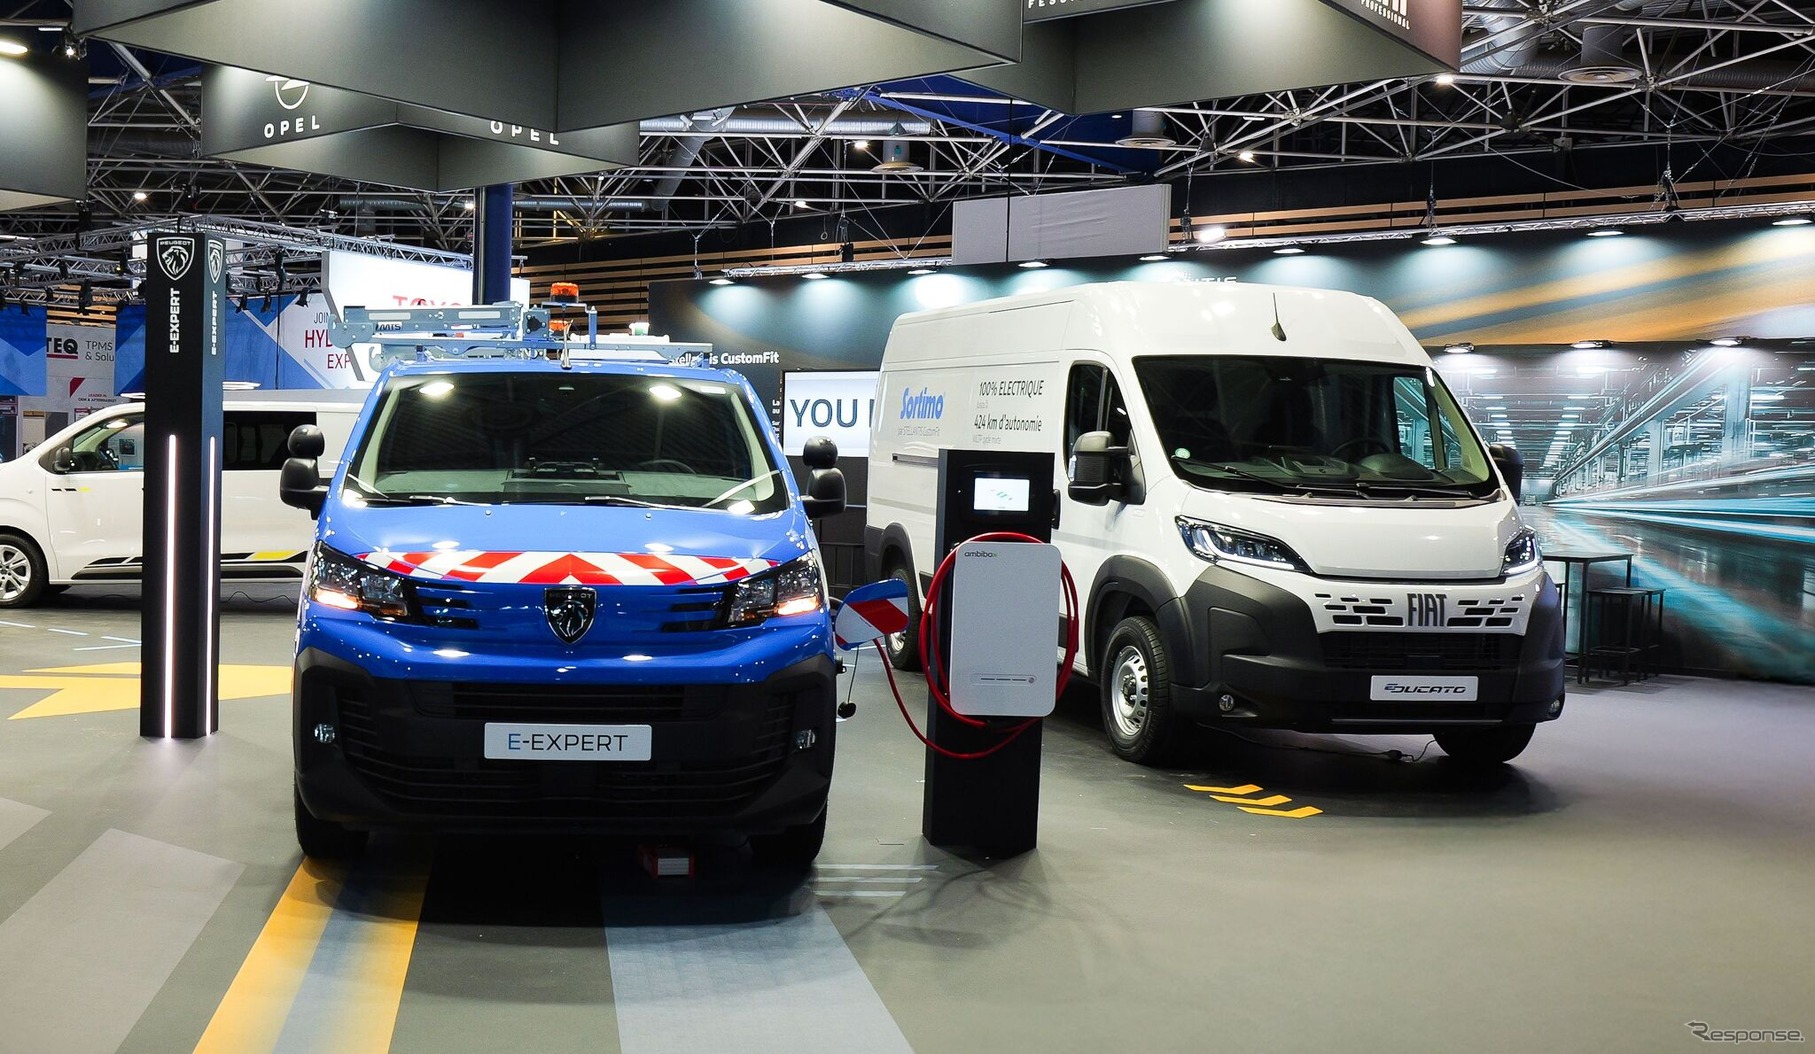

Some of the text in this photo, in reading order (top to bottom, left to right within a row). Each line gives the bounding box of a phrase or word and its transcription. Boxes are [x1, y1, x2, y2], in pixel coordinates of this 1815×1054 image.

[264, 115, 320, 138] OPEL
[490, 120, 559, 146] OPEL
[169, 288, 180, 354] E-EXPERT
[85, 340, 113, 351] TPMS
[85, 352, 92, 360] &
[720, 351, 780, 365] CustomFit
[980, 380, 1044, 398] 100% ELECTRIQUE
[790, 398, 858, 428] YOU
[900, 387, 944, 419] Sortimo
[974, 413, 1043, 431] 424 km d'autonomie
[1406, 593, 1448, 627] FIAT
[508, 733, 629, 752] E-EXPERT
